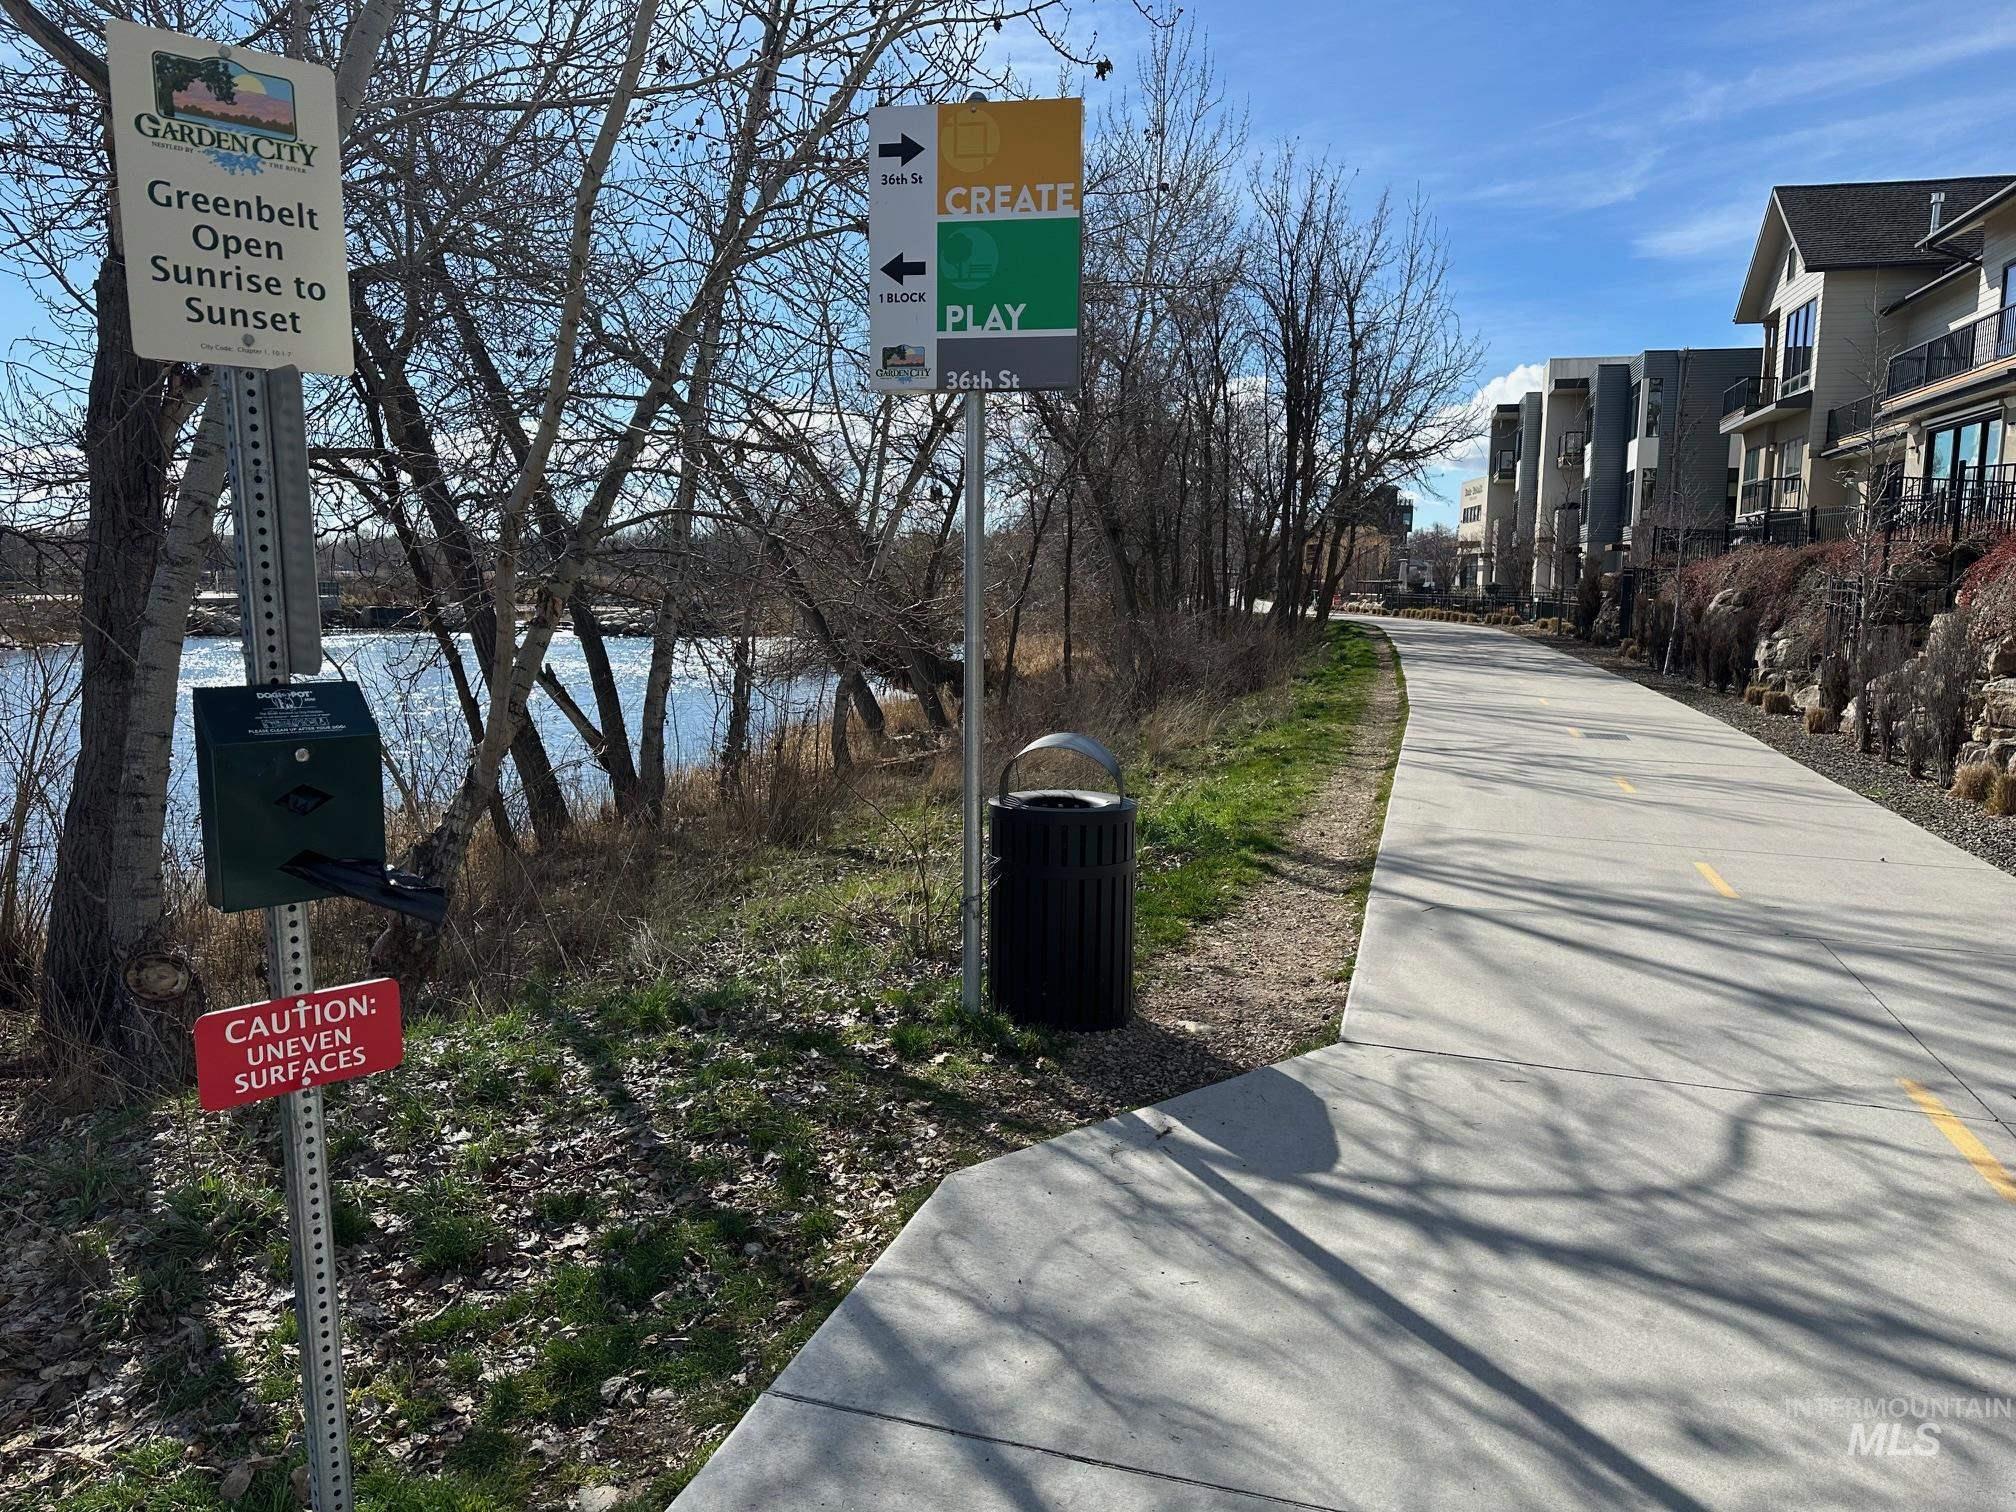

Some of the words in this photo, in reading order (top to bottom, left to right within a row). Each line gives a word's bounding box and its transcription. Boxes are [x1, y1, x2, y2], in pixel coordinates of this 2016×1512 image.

[134, 113, 248, 154] GARDEN
[253, 137, 318, 167] CITY
[151, 141, 183, 153] NESTLED
[269, 162, 284, 170] THE
[286, 164, 307, 174] RIVER
[880, 173, 908, 185] 36th
[911, 172, 923, 185] St
[147, 180, 319, 231] Greenbelt
[945, 182, 1074, 215] CREATE
[192, 224, 283, 260] Open
[151, 255, 282, 296] Sunrise
[294, 277, 326, 301] to
[185, 296, 301, 334] Sunset
[879, 293, 884, 303] 1
[887, 292, 926, 304] BLOCK
[946, 303, 1027, 332] PLAY
[200, 343, 213, 351] City
[875, 368, 909, 378] GARDEN
[910, 367, 931, 377] CITY
[946, 370, 993, 390] 36th
[998, 369, 1020, 389] St
[224, 994, 376, 1044] CAUTION:
[247, 1026, 351, 1066] UNEVEN
[234, 1046, 366, 1094] SURFACES
